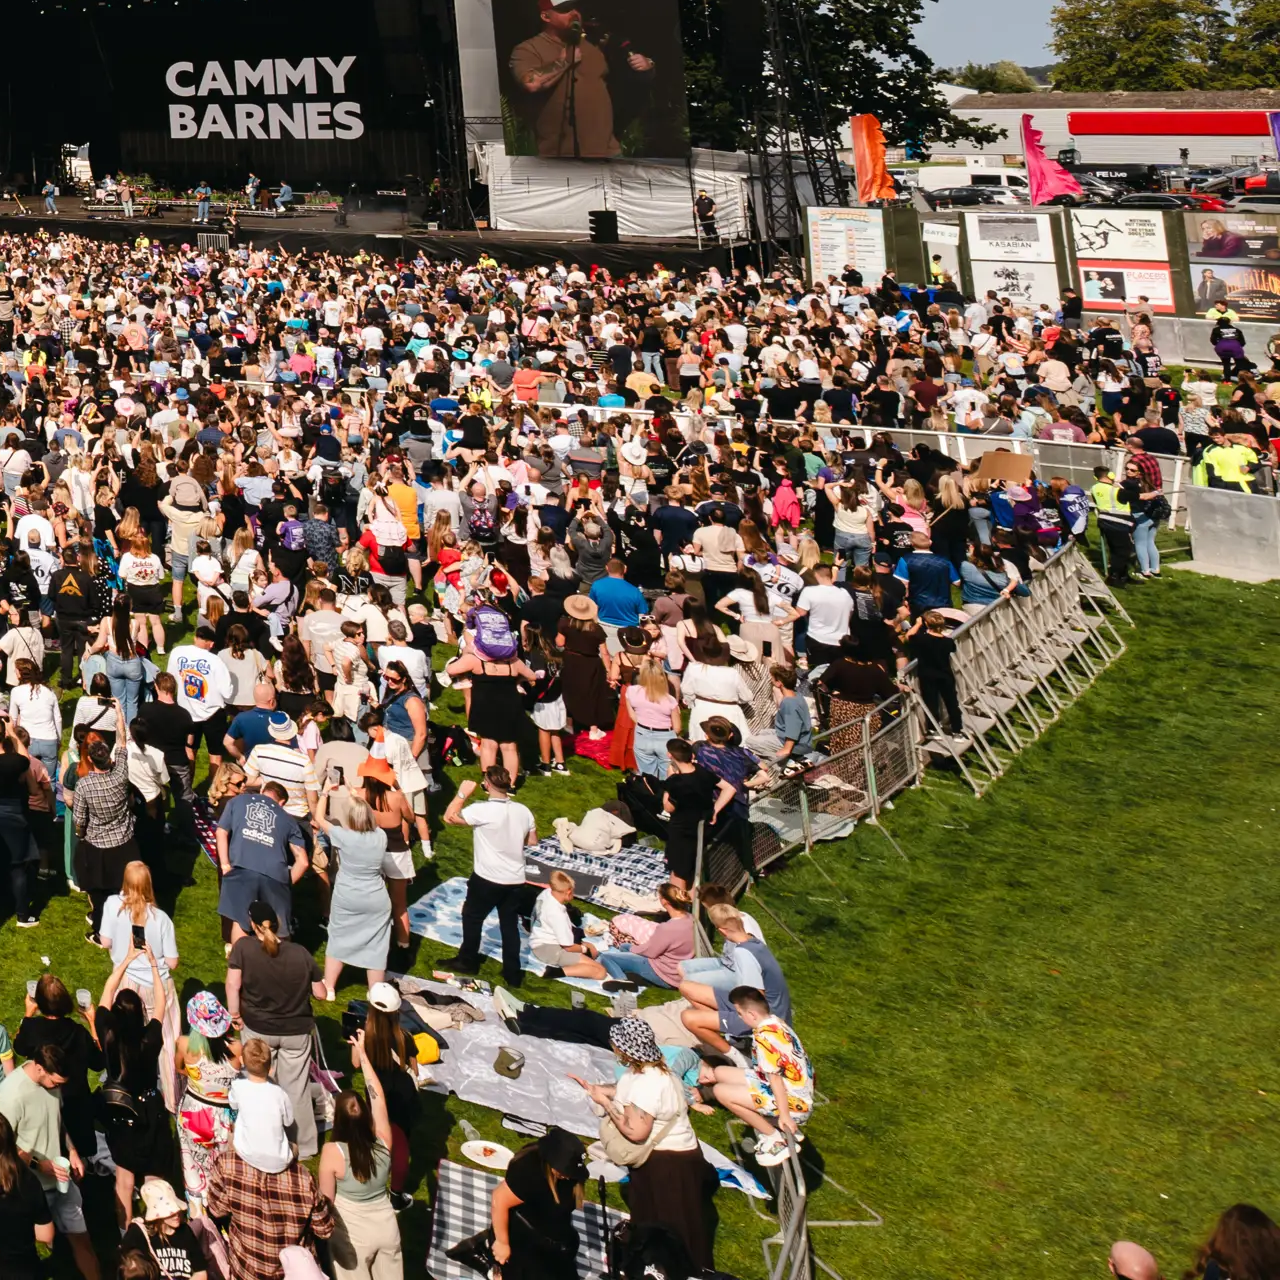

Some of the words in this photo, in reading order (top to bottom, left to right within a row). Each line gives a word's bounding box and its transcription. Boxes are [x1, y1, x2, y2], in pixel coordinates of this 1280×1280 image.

[165, 55, 357, 98] CAMMY
[169, 101, 365, 141] BARNES
[989, 241, 1032, 249] KASABIAN
[763, 573, 791, 594] 26
[242, 828, 275, 844] adidas
[156, 1247, 187, 1259] NATHAN
